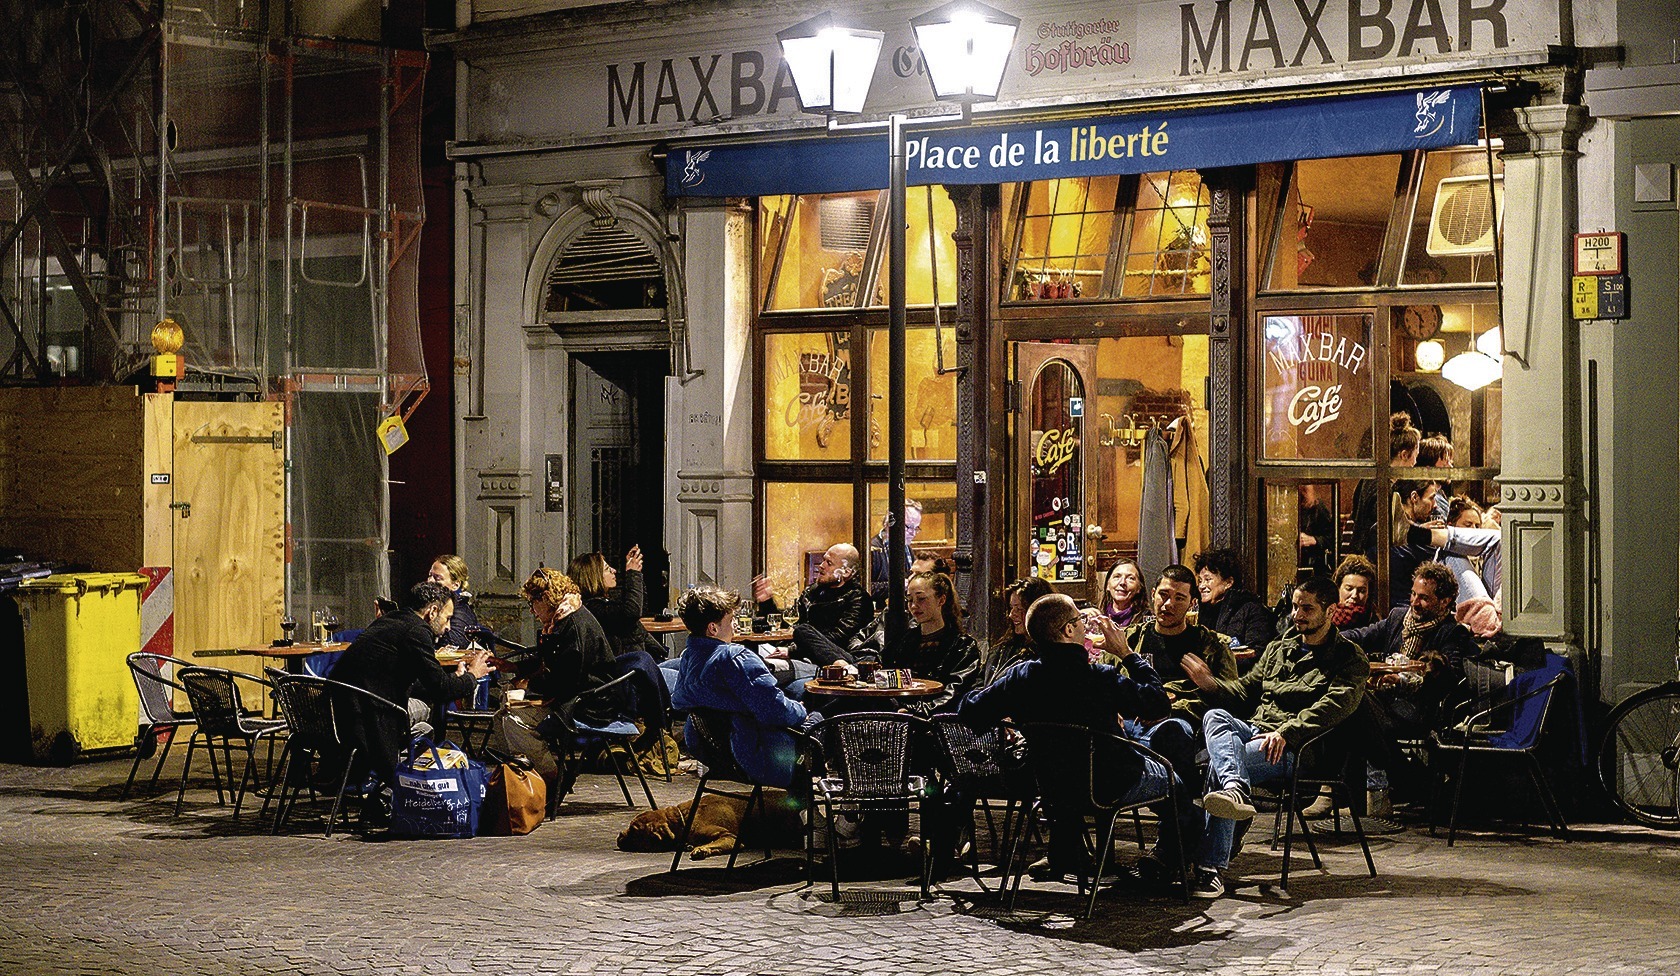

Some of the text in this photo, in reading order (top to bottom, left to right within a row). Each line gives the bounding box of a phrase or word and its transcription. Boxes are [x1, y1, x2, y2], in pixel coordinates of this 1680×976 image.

[1037, 18, 1120, 39] Stuttgarter
[1025, 37, 1131, 77] Hofbräu
[905, 122, 1168, 170] Place de la liberté
[1585, 237, 1610, 247] H200
[1579, 282, 1585, 292] R
[1604, 281, 1612, 291] S
[785, 391, 828, 431] Café
[1287, 384, 1343, 436] Café
[1037, 427, 1076, 475] Café
[404, 797, 455, 811] Heidelberg
